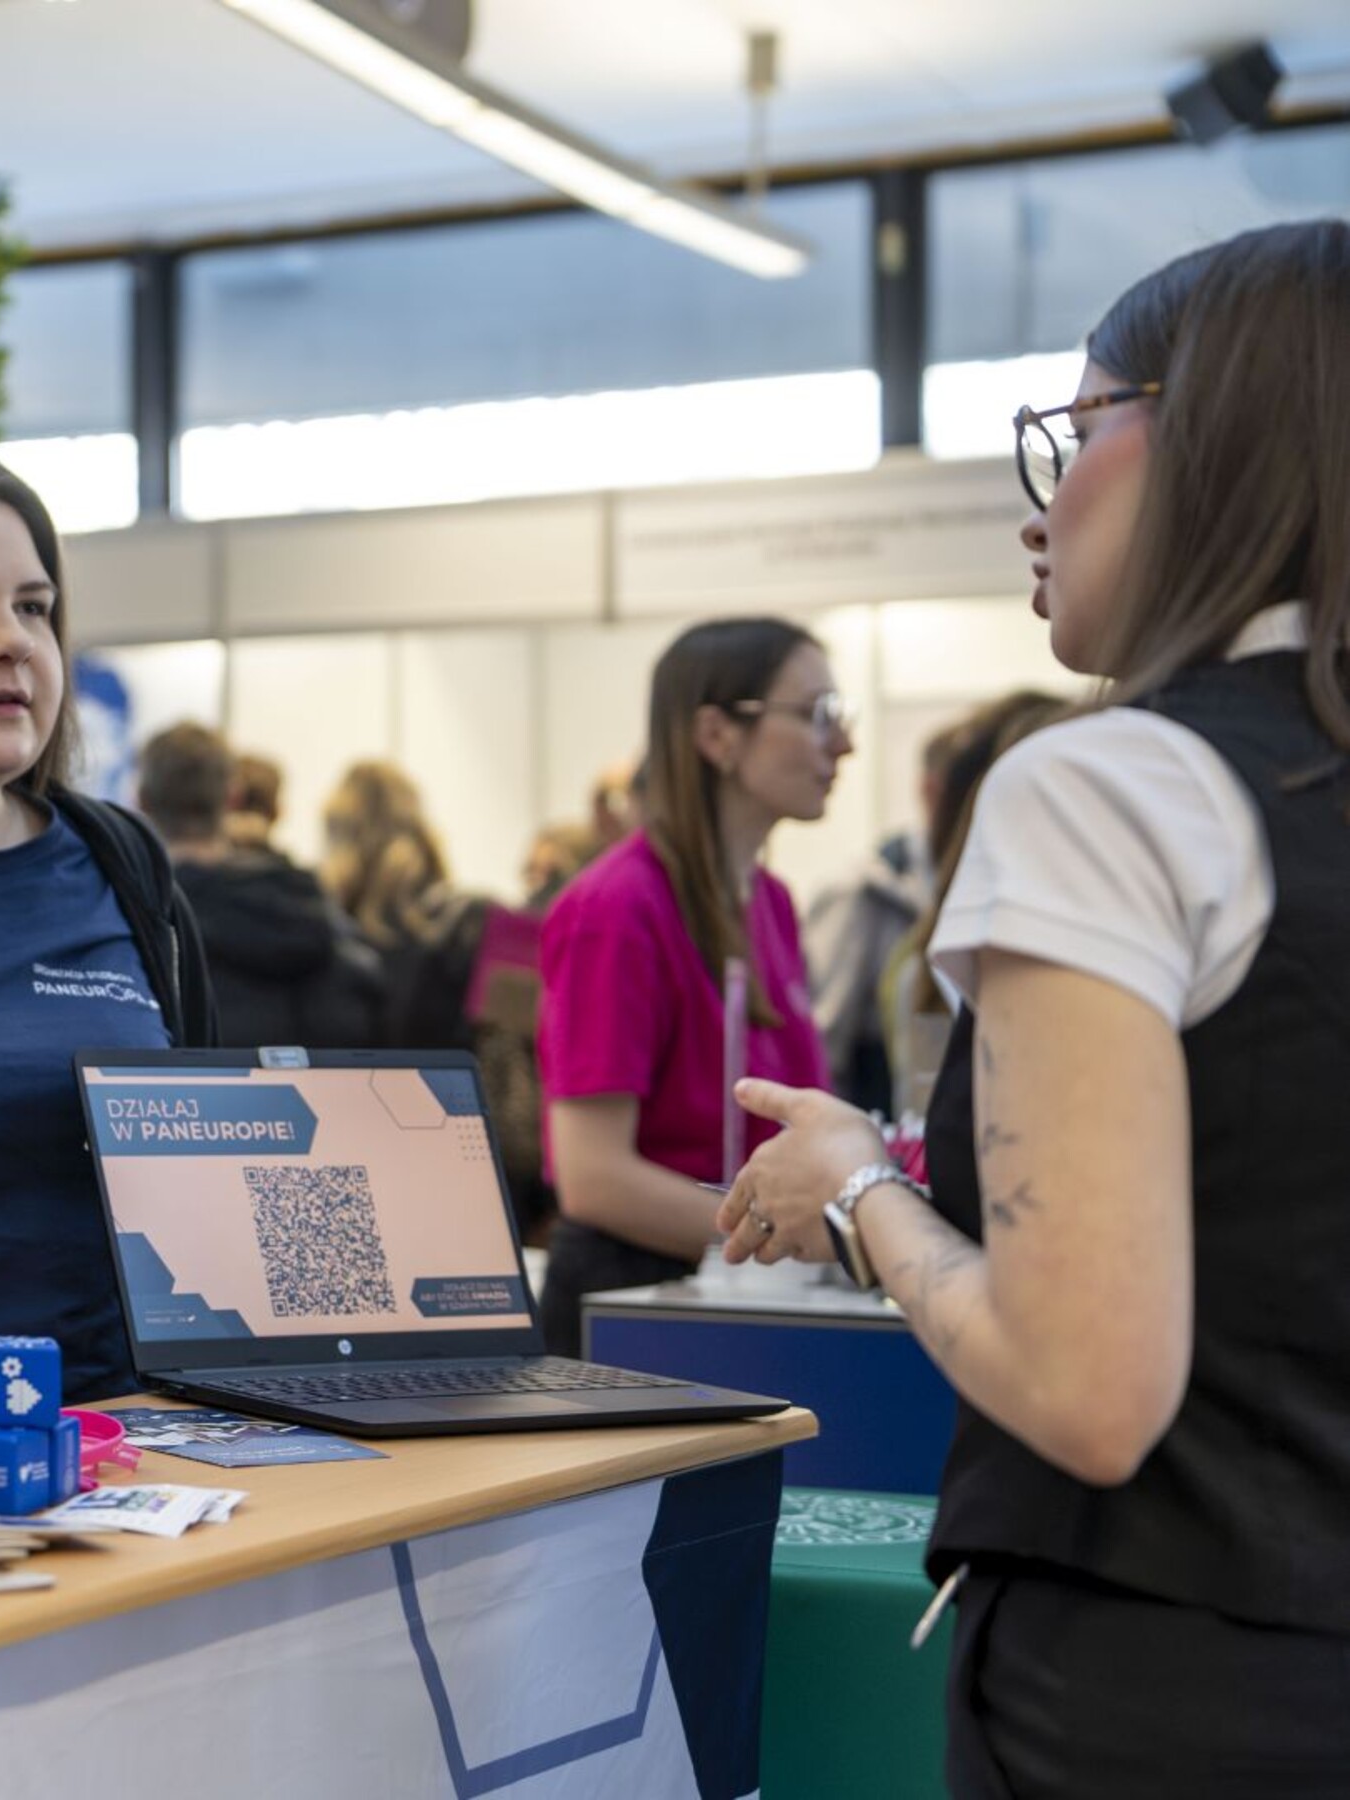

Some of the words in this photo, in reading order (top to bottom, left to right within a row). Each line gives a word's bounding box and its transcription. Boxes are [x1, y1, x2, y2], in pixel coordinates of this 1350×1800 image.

[107, 1099, 199, 1119] DZIAŁAJ
[110, 1122, 133, 1141] W
[141, 1121, 296, 1141] PANEUROPIE!
